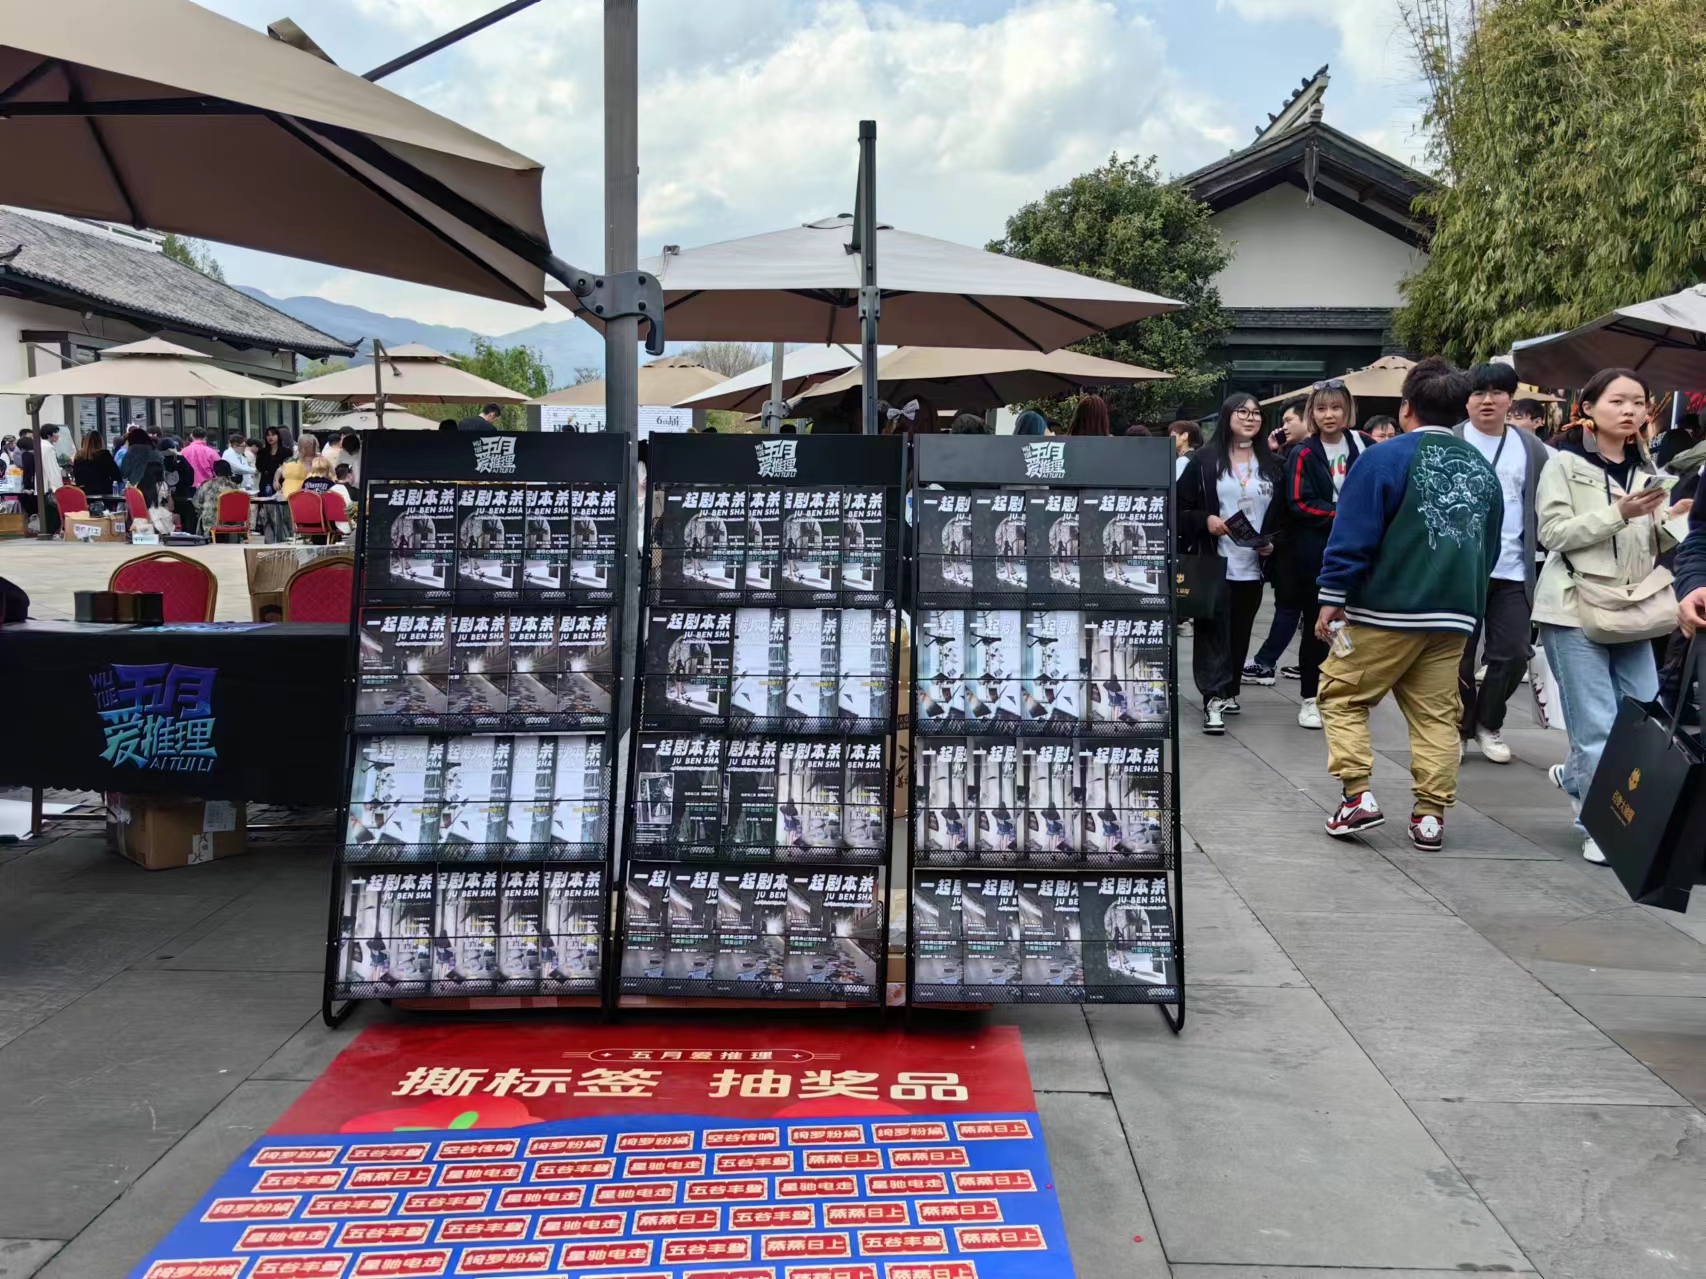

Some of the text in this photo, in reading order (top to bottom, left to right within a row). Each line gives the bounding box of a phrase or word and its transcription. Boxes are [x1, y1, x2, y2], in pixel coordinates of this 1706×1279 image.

[480, 436, 517, 455] 五月
[762, 439, 798, 459] 五月
[1029, 441, 1066, 460] 五月
[475, 453, 516, 473] 爱推理
[757, 457, 797, 477] 爱推理
[1024, 458, 1066, 478] 爱推理
[374, 489, 455, 506] 一起剧本杀
[459, 490, 524, 507] 起剧本杀
[571, 490, 616, 507] 剧本杀
[668, 491, 746, 508] 一起剧本杀
[1083, 495, 1164, 512] 一起剧本杀
[419, 506, 436, 514] BEN
[475, 507, 485, 515] JU
[507, 506, 524, 514] SHA
[581, 507, 616, 516] BEN SHA
[699, 508, 745, 517] JU BEN SHA
[764, 508, 780, 516] SHA
[956, 513, 965, 521] JU
[1009, 513, 1018, 521] JU
[1062, 513, 1072, 521] JU
[1116, 513, 1164, 521] JU BEN SHA
[366, 616, 446, 632] 一起剧本杀
[510, 616, 555, 632] 剧本杀
[560, 615, 607, 632] 剧本杀
[652, 613, 731, 630] 一起剧本杀
[683, 631, 693, 639] JU
[714, 630, 730, 638] SHA
[1084, 620, 1164, 637] 一起剧本杀
[397, 633, 407, 641] JU
[429, 632, 445, 640] SHA
[538, 632, 553, 640] SHA
[560, 631, 607, 641] JU BEN SHA
[1128, 637, 1164, 645] BEN SHA
[111, 663, 218, 719] 五月
[97, 710, 218, 769] 爱推理
[642, 740, 721, 756] 一起剧本杀
[672, 757, 682, 766] JU
[685, 757, 702, 765] BEN
[1078, 747, 1160, 764] 一起剧本杀
[150, 756, 215, 773] AI TUI LI
[493, 760, 509, 768] SHA
[807, 760, 841, 768] BEN SHA
[1124, 765, 1141, 773] BEN
[1142, 765, 1159, 773] SHA
[352, 874, 433, 892] 一起剧本杀
[793, 875, 874, 892] 一起剧本杀
[1083, 878, 1166, 895] 一起剧本杀
[416, 891, 432, 899] SHA
[707, 890, 718, 899] JU
[756, 891, 786, 900] JU BEN
[825, 893, 835, 901] JU
[857, 892, 873, 900] SHA
[953, 897, 962, 905] JU
[1117, 896, 1167, 905] JU BEN SHA
[1000, 897, 1009, 906] JU
[1055, 897, 1065, 906] JU
[629, 1050, 774, 1060] 五月爱推理
[391, 1066, 969, 1101] 撕标签 抽奖品
[959, 1123, 1026, 1135] 蒸蒸日上
[706, 1132, 775, 1143] 空谷传响
[349, 1147, 423, 1158] 五谷丰登
[440, 1143, 513, 1155] 空谷传响
[718, 1156, 789, 1168] 五谷丰登
[808, 1153, 877, 1165] 蒸蒸日上
[894, 1151, 963, 1162] 蒸蒸日上
[536, 1163, 610, 1175] 五谷丰登
[629, 1160, 700, 1172] 星驰电走
[353, 1170, 428, 1183] 蒸蒸日上
[445, 1167, 519, 1180] 星驰电走
[261, 1174, 338, 1187] 五谷丰登
[780, 1181, 852, 1192] 星驰电走
[871, 1178, 942, 1190] 星驰电走
[957, 1175, 1029, 1187] 蒸蒸日上
[597, 1187, 672, 1200] 星驰电走
[689, 1183, 763, 1196] 五谷丰登
[406, 1195, 484, 1208] 五谷丰登
[503, 1191, 579, 1204] 星驰电走
[310, 1199, 390, 1211] 五谷丰登
[921, 1204, 996, 1217] 蒸蒸日上
[638, 1213, 715, 1227] 蒸蒸日上
[733, 1210, 810, 1223] 五谷丰登
[828, 1207, 903, 1220] 蒸蒸日上
[443, 1221, 524, 1235] 五谷丰登
[542, 1218, 620, 1232] 星驰电走
[243, 1229, 327, 1244] 星驰电走
[343, 1226, 426, 1240] 五谷丰登
[961, 1231, 1039, 1245] 蒸蒸日上
[766, 1238, 845, 1252] 蒸蒸日上
[863, 1235, 942, 1249] 五谷丰登
[565, 1247, 647, 1262] 星驰电走
[665, 1242, 746, 1257] 五谷丰登
[255, 1259, 342, 1276] 五谷丰登
[359, 1255, 443, 1271] 星驰电走
